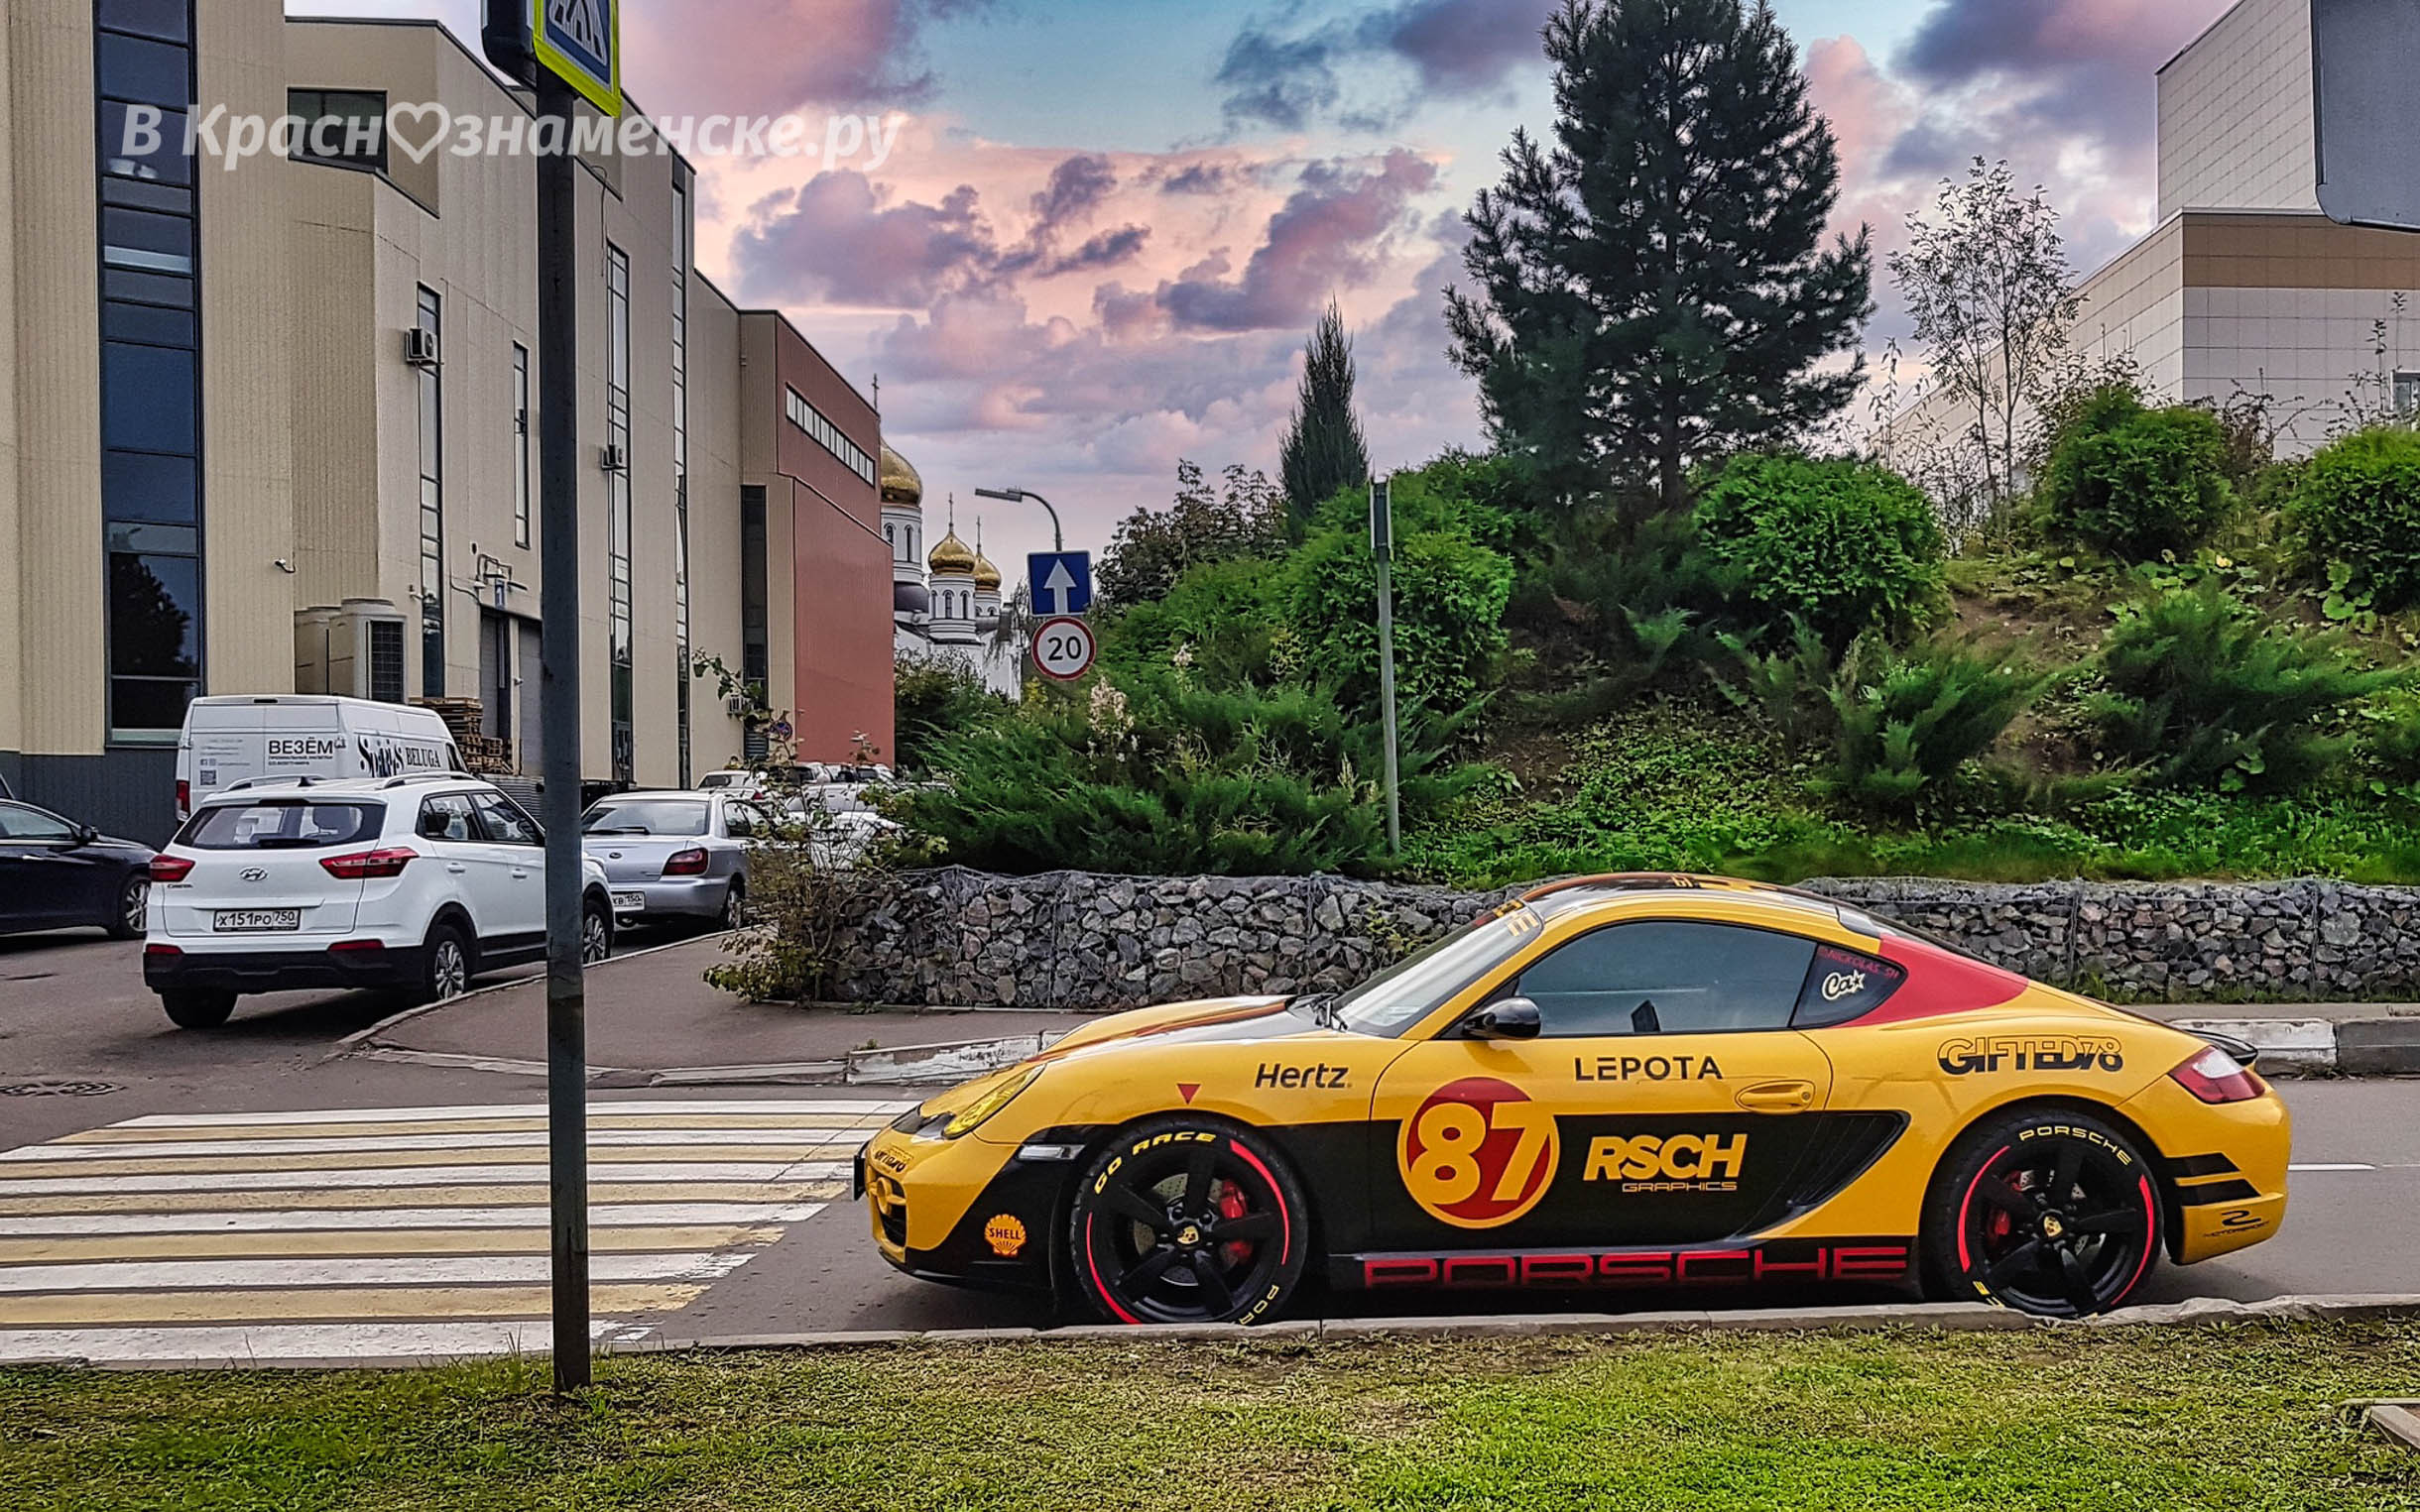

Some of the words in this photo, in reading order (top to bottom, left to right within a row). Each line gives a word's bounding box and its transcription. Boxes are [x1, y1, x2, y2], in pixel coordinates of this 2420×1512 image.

[1047, 636, 1082, 661] 20
[269, 736, 333, 755] ВЕЗЁМ
[405, 746, 441, 768] BELUGA
[274, 910, 296, 922] 750
[1937, 1033, 2124, 1076] GIFTED78
[1574, 1055, 1724, 1082] LEPOTA
[1409, 1100, 1550, 1206] 87
[1583, 1133, 1748, 1181] RSCH
[2018, 1125, 2132, 1166] PORSCHE
[1094, 1156, 1123, 1195] GO
[1132, 1131, 1217, 1156] RACE
[1622, 1181, 1738, 1193] GRAPHICS
[989, 1227, 1022, 1240] SHELL
[1363, 1245, 1908, 1289] PORSCHE
